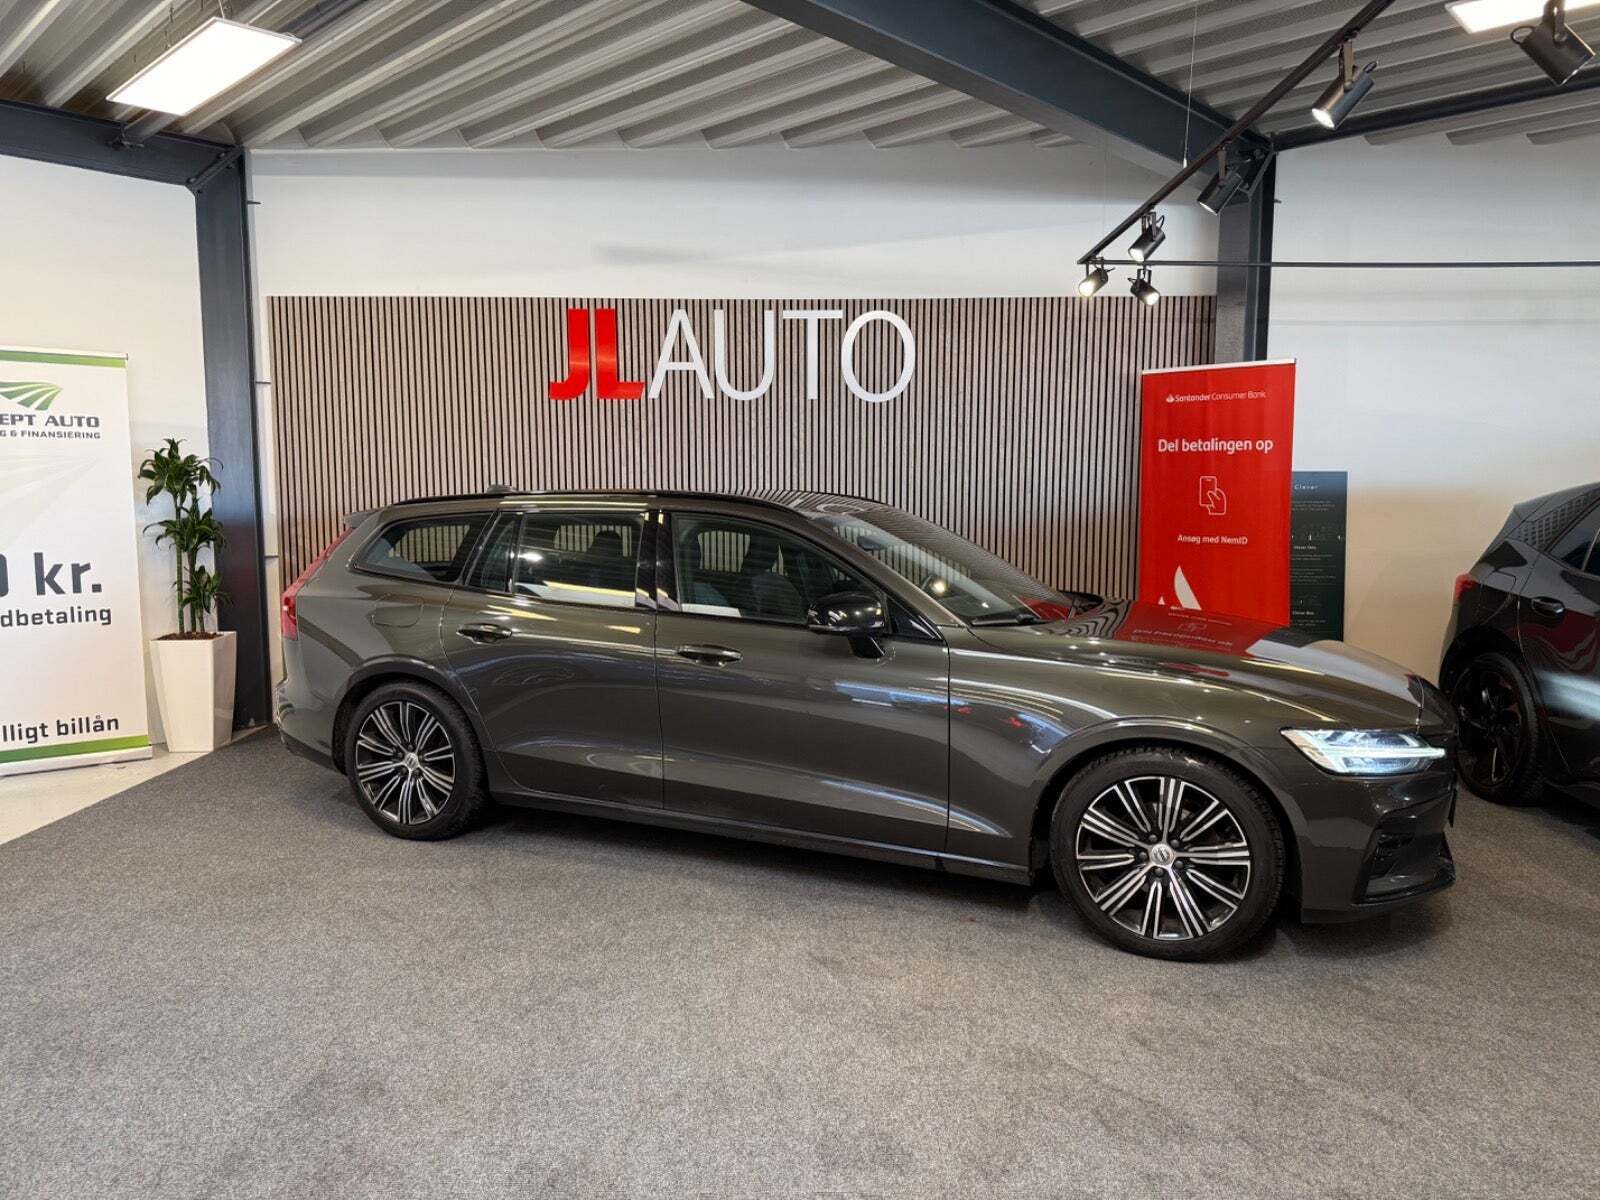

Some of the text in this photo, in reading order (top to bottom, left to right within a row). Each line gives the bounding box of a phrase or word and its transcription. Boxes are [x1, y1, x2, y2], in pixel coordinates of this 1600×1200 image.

[647, 308, 916, 403] AUTO
[1175, 390, 1266, 402] Santander Consumer Bank
[45, 415, 100, 428] AUTO
[21, 430, 101, 439] FINANSIERING
[1158, 437, 1274, 455] Del betalingen op
[1202, 535, 1219, 543] med
[33, 552, 102, 596] kr.
[0, 606, 112, 627] dbetaling
[2, 715, 119, 744] lligt billån
